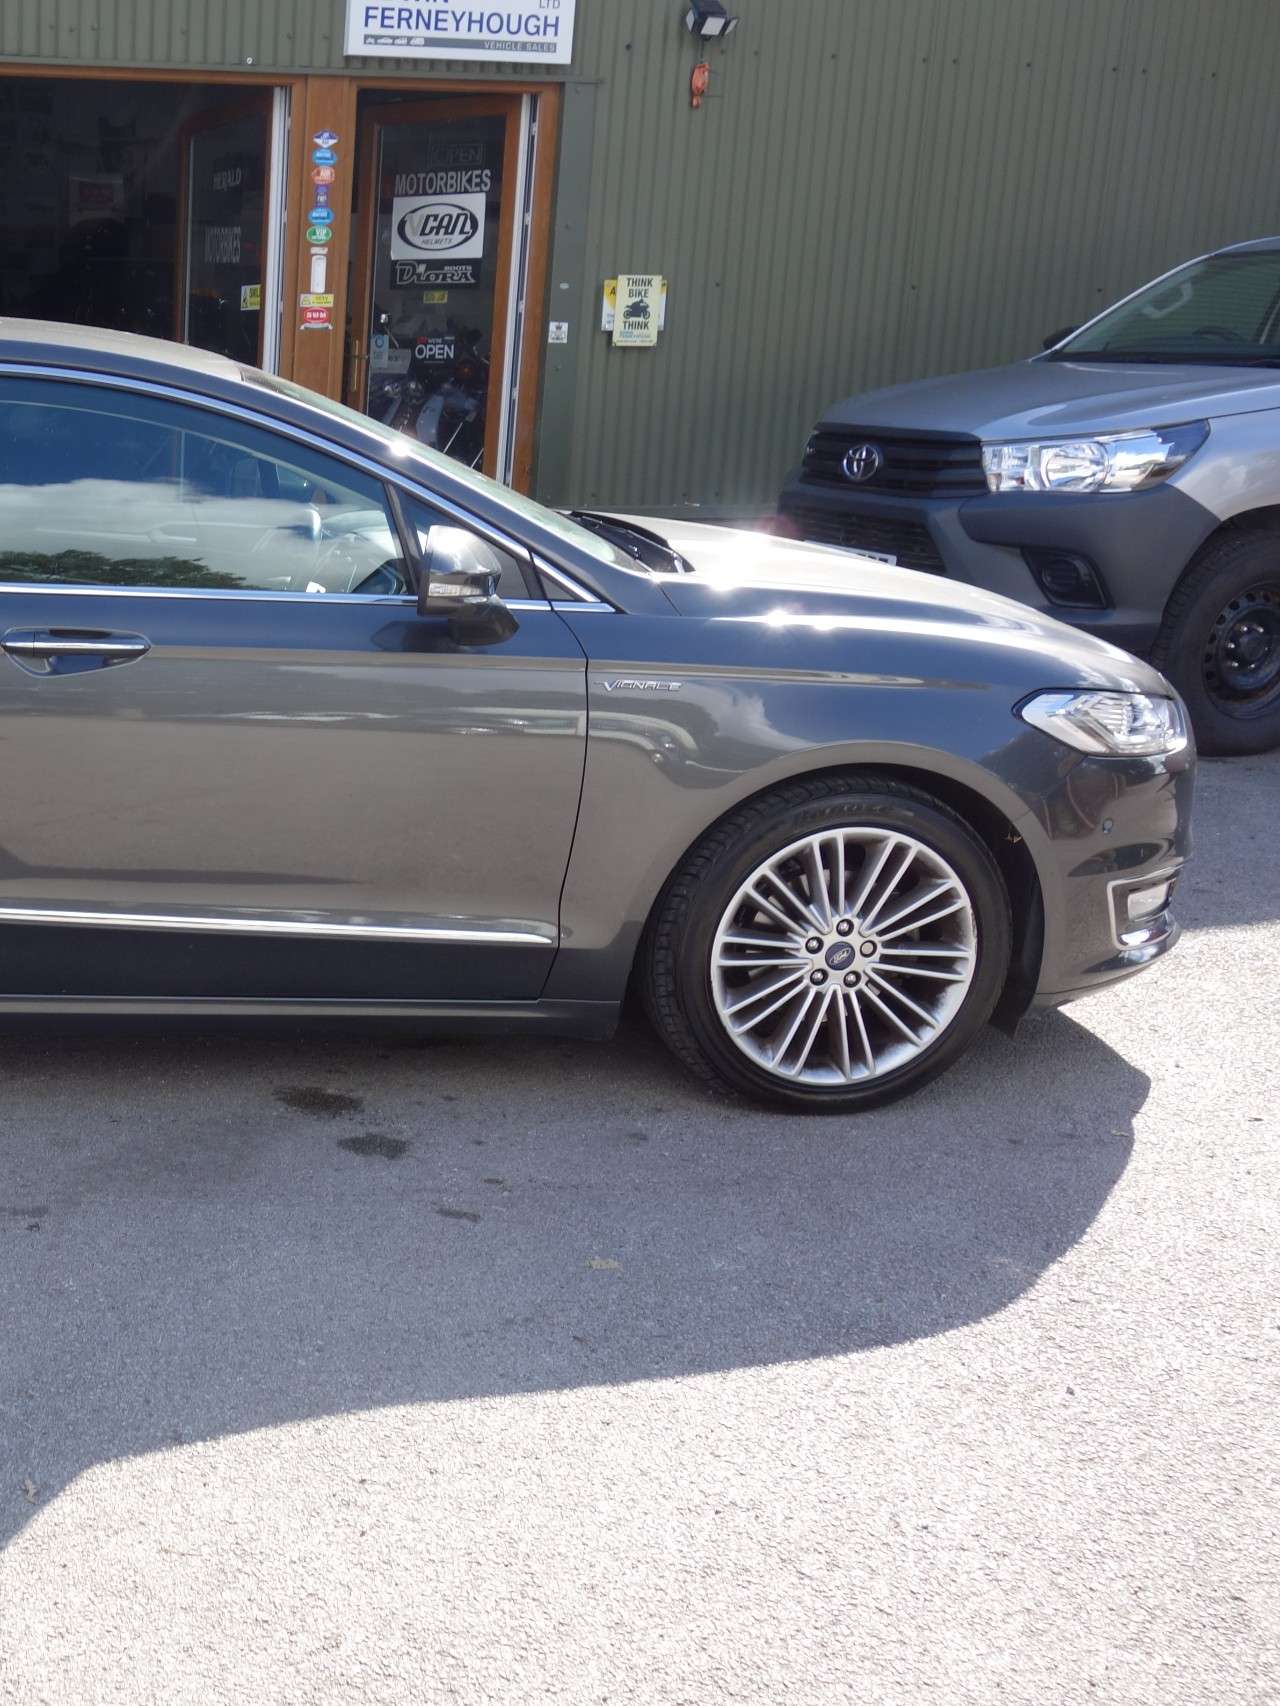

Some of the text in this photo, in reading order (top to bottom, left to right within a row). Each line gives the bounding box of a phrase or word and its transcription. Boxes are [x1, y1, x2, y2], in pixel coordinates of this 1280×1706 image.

[538, 0, 561, 9] LTD
[363, 6, 560, 37] FERNEYHOUGH
[484, 41, 556, 52] VEHICLE SALES
[394, 169, 491, 195] MOTORBIKES
[421, 237, 453, 245] HELMETS
[626, 277, 653, 288] THINK
[628, 288, 650, 298] BIKE
[622, 320, 650, 331] THINK
[415, 344, 455, 360] OPEN
